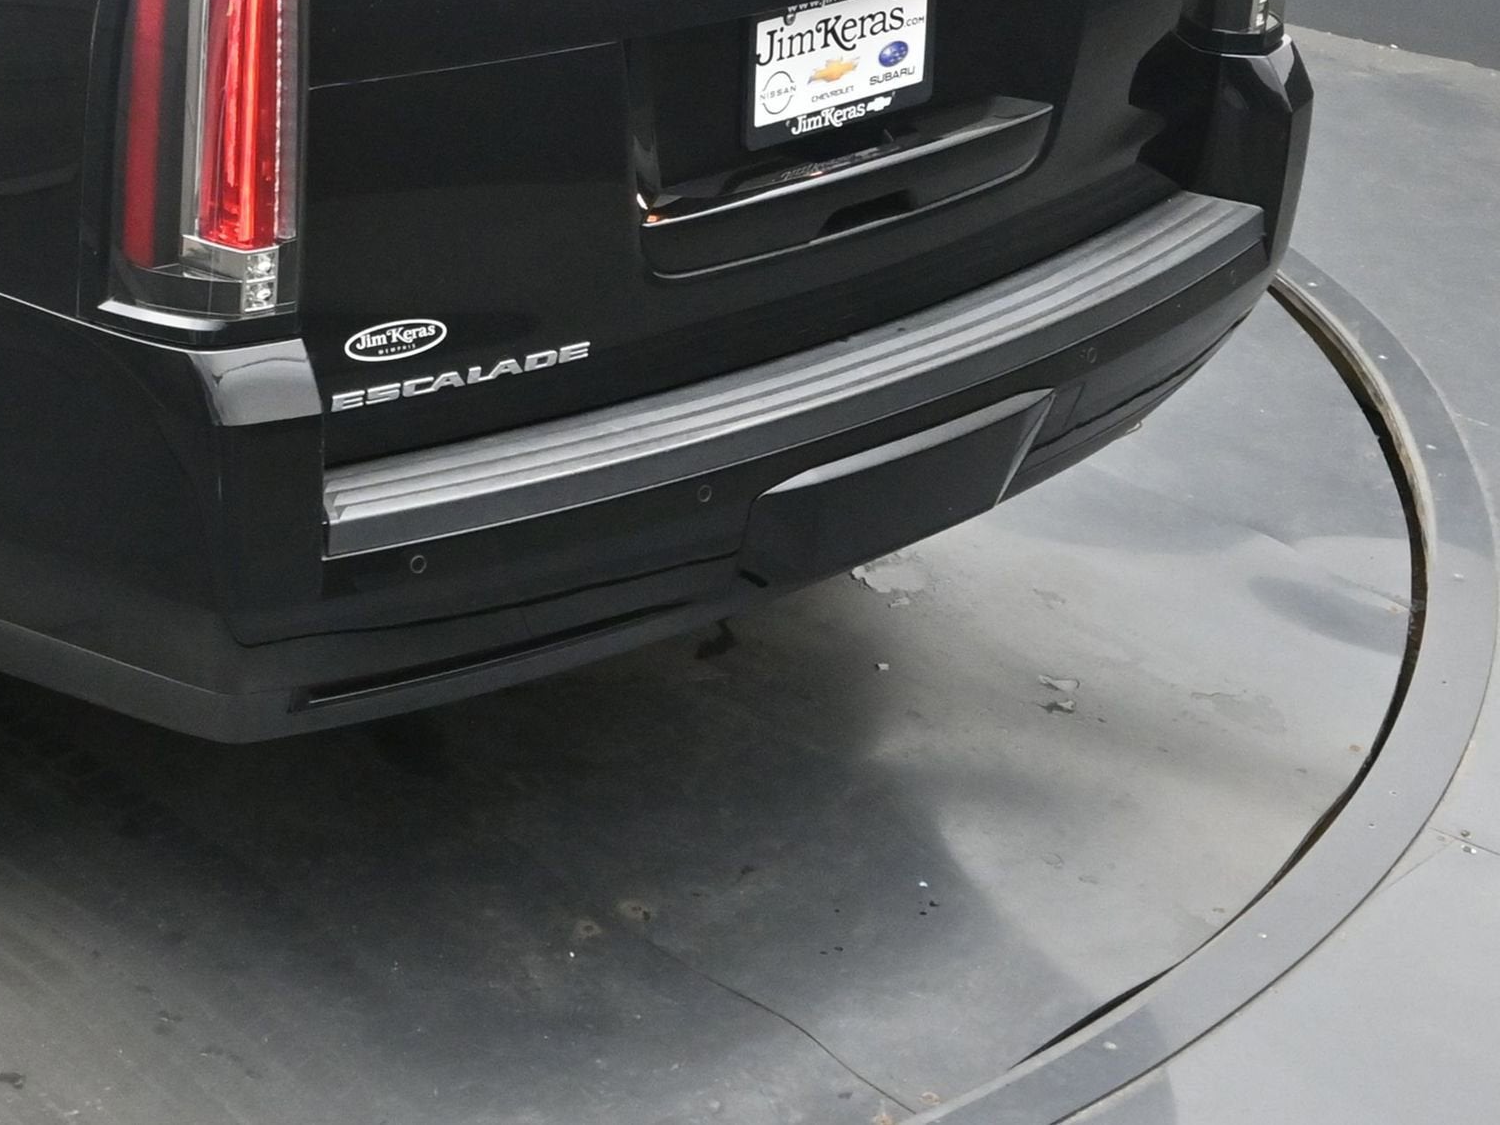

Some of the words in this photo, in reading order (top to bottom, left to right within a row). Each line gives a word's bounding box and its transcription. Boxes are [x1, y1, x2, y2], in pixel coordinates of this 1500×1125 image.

[869, 66, 916, 86] SUBARU
[760, 85, 797, 100] NISSAN
[811, 85, 855, 103] CHEVROLET
[330, 341, 591, 413] ESCALADE
